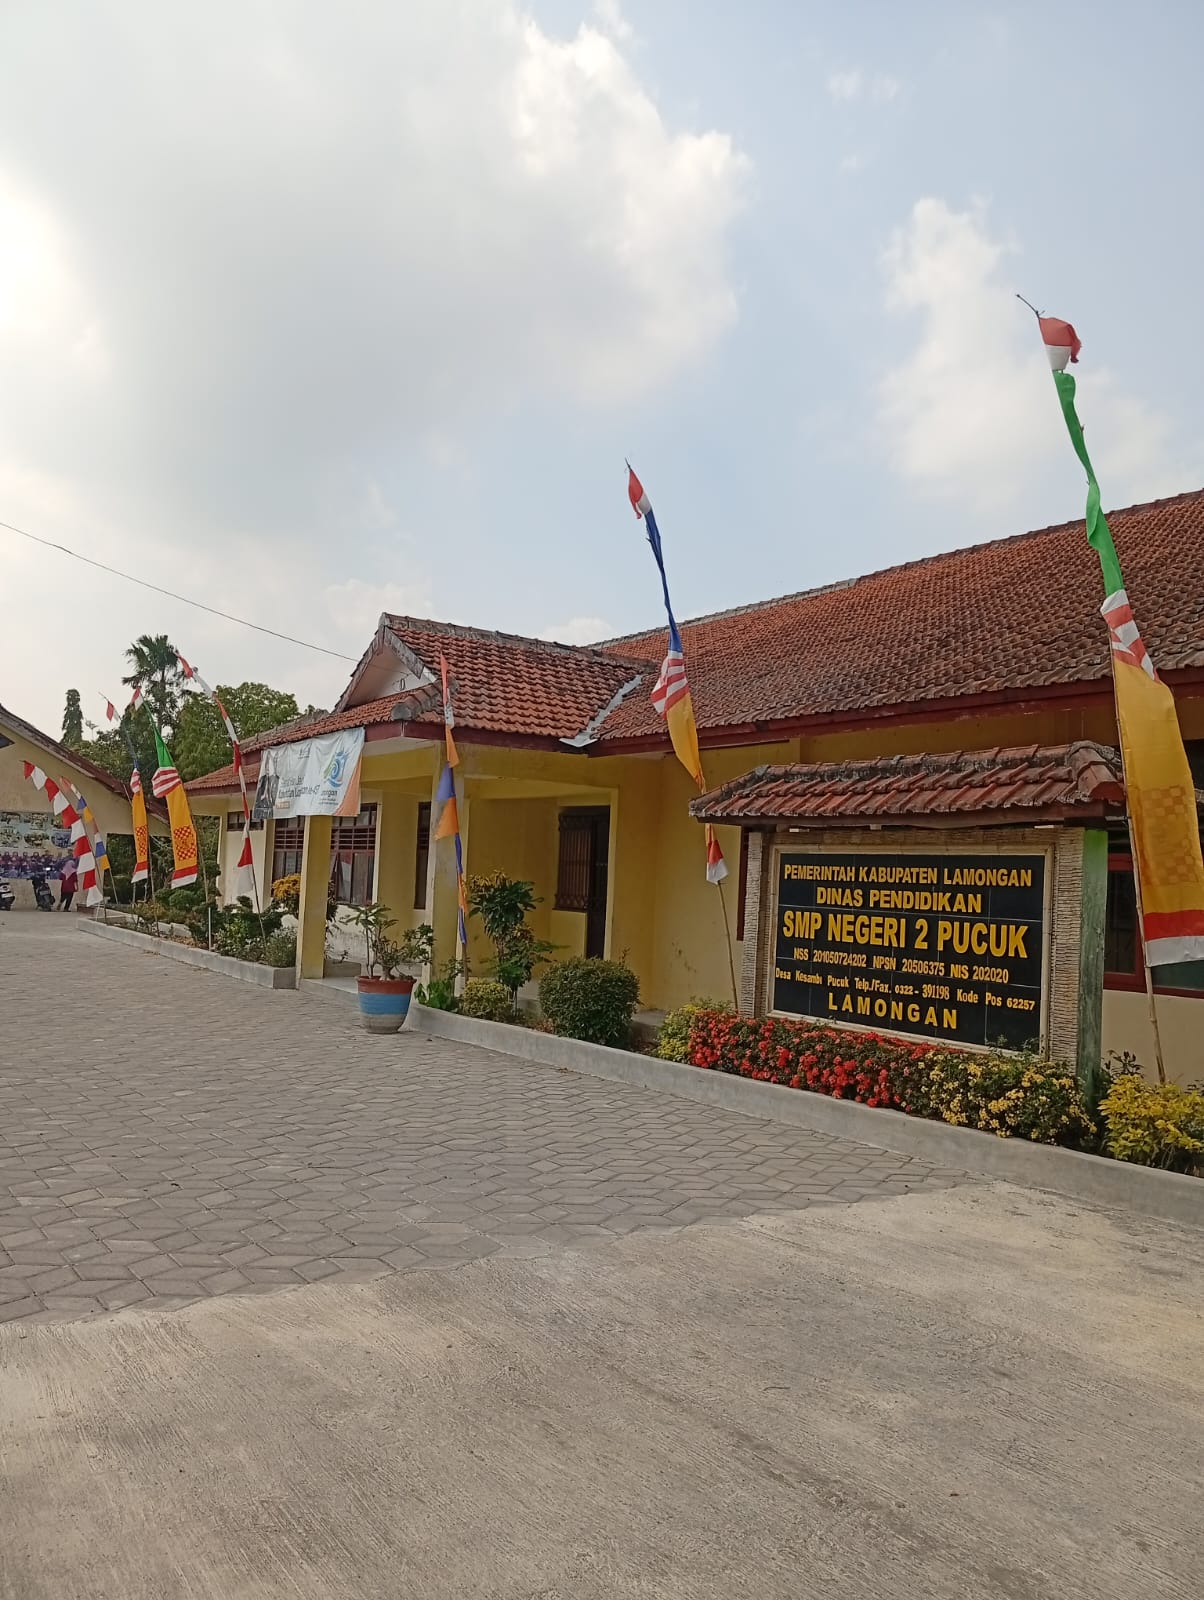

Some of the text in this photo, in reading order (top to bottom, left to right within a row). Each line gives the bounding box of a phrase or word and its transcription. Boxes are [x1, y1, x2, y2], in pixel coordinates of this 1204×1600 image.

[784, 865, 1032, 886] PEMERINTAH KABUPATEN LAMONGAN
[817, 887, 981, 913] DINAS PENDIDIKAN
[783, 911, 1028, 958] SMP NEGERI 2 PUCUK
[794, 947, 1009, 983] NSS 201050724202 NPSN 20506375 NIS 202020
[775, 968, 791, 980] Desa
[827, 975, 849, 987] Pucuk
[957, 989, 978, 1003] Kode
[986, 993, 1002, 1006] Pos
[1007, 998, 1035, 1011] 62257
[828, 993, 957, 1029] LAMONGAN
